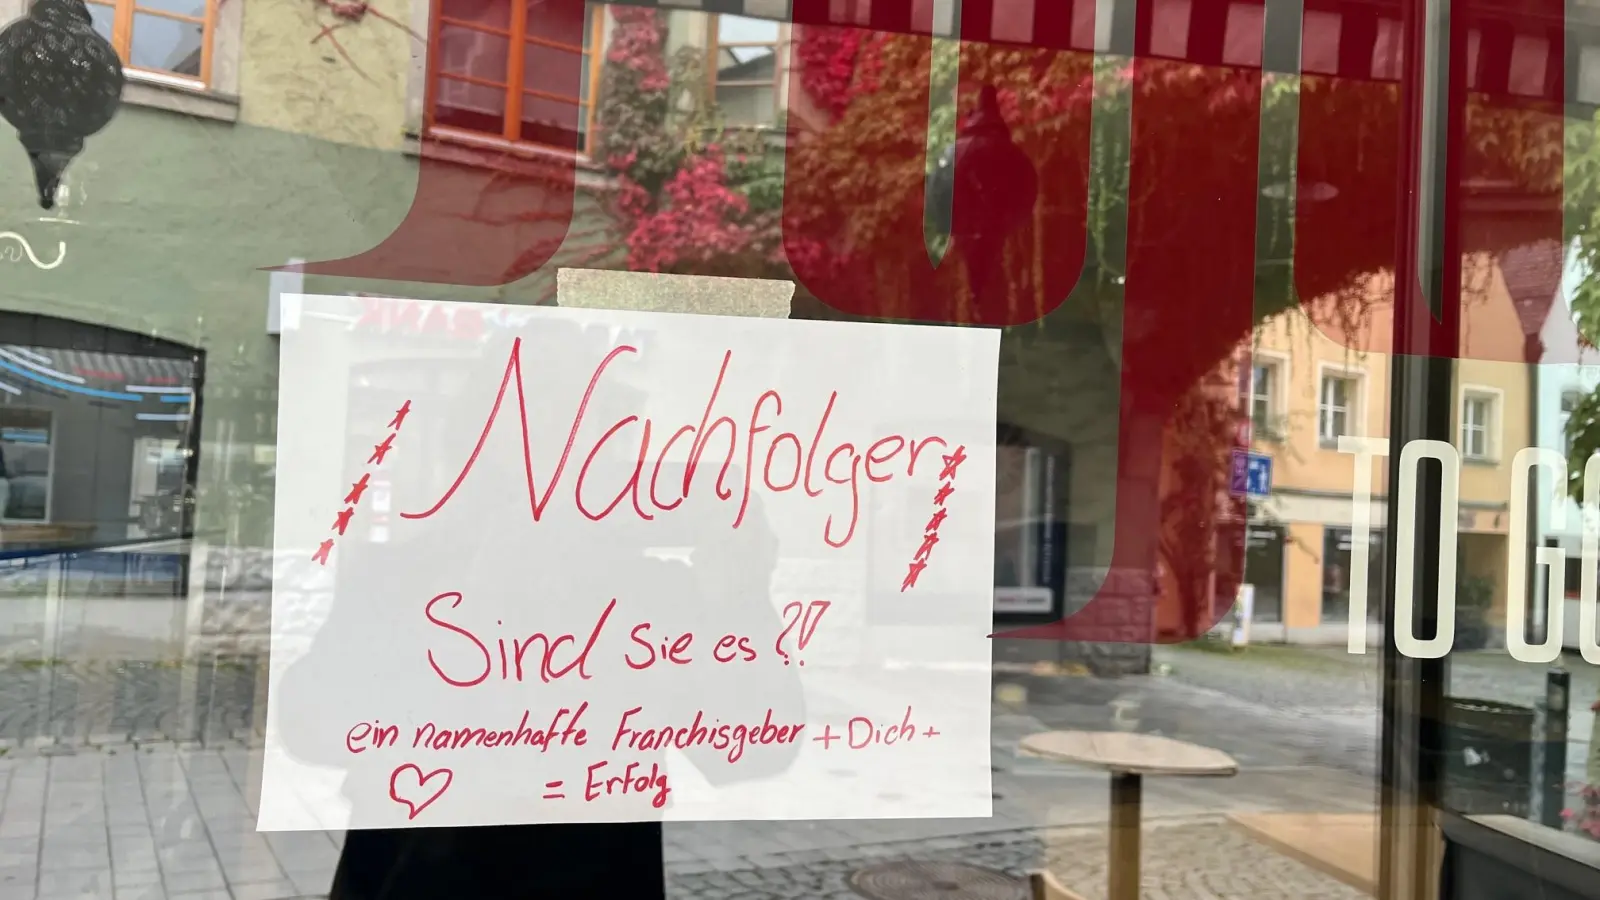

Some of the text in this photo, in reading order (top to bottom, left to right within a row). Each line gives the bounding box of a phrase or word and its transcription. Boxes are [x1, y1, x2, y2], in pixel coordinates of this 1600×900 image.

[400, 337, 945, 549] Nachfolger
[1337, 435, 1460, 659] TO
[424, 591, 617, 688] Sind
[713, 634, 758, 664] es
[345, 720, 399, 755] ein
[413, 700, 589, 754] namenhafte
[611, 706, 806, 764] Franchisgeber
[847, 705, 917, 750] Dich
